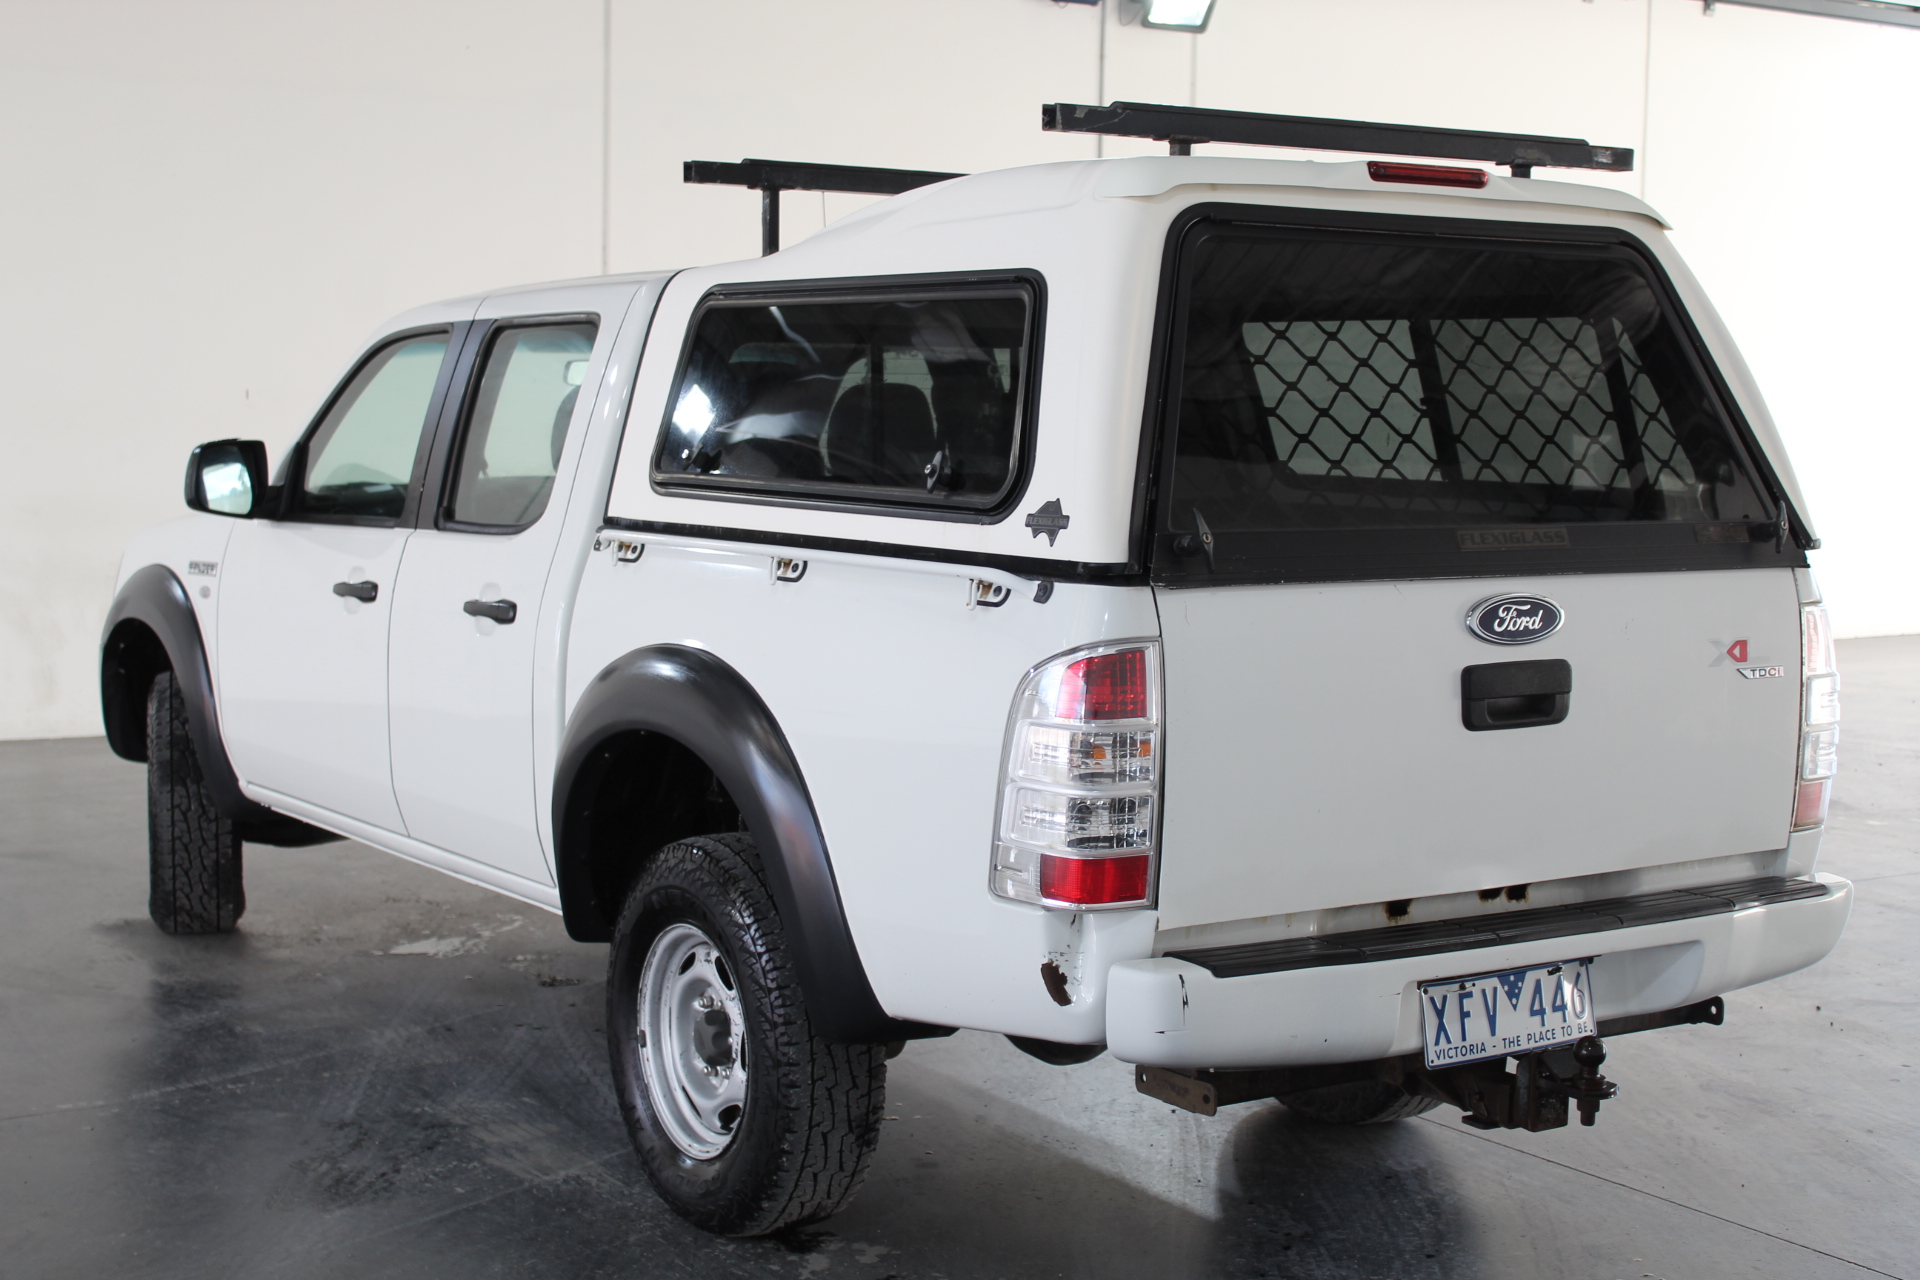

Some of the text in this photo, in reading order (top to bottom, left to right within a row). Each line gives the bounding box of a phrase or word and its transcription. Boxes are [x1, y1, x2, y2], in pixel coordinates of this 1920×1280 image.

[1459, 530, 1566, 546] FLEXIGLASS
[1493, 604, 1544, 632] Ford
[1429, 971, 1588, 1047] XFV 446
[1435, 1041, 1487, 1061] VICTORIA
[1502, 1035, 1522, 1050] THE
[1527, 1028, 1557, 1046] PLACE
[1560, 1023, 1573, 1038] TO
[1577, 1020, 1588, 1035] BE
